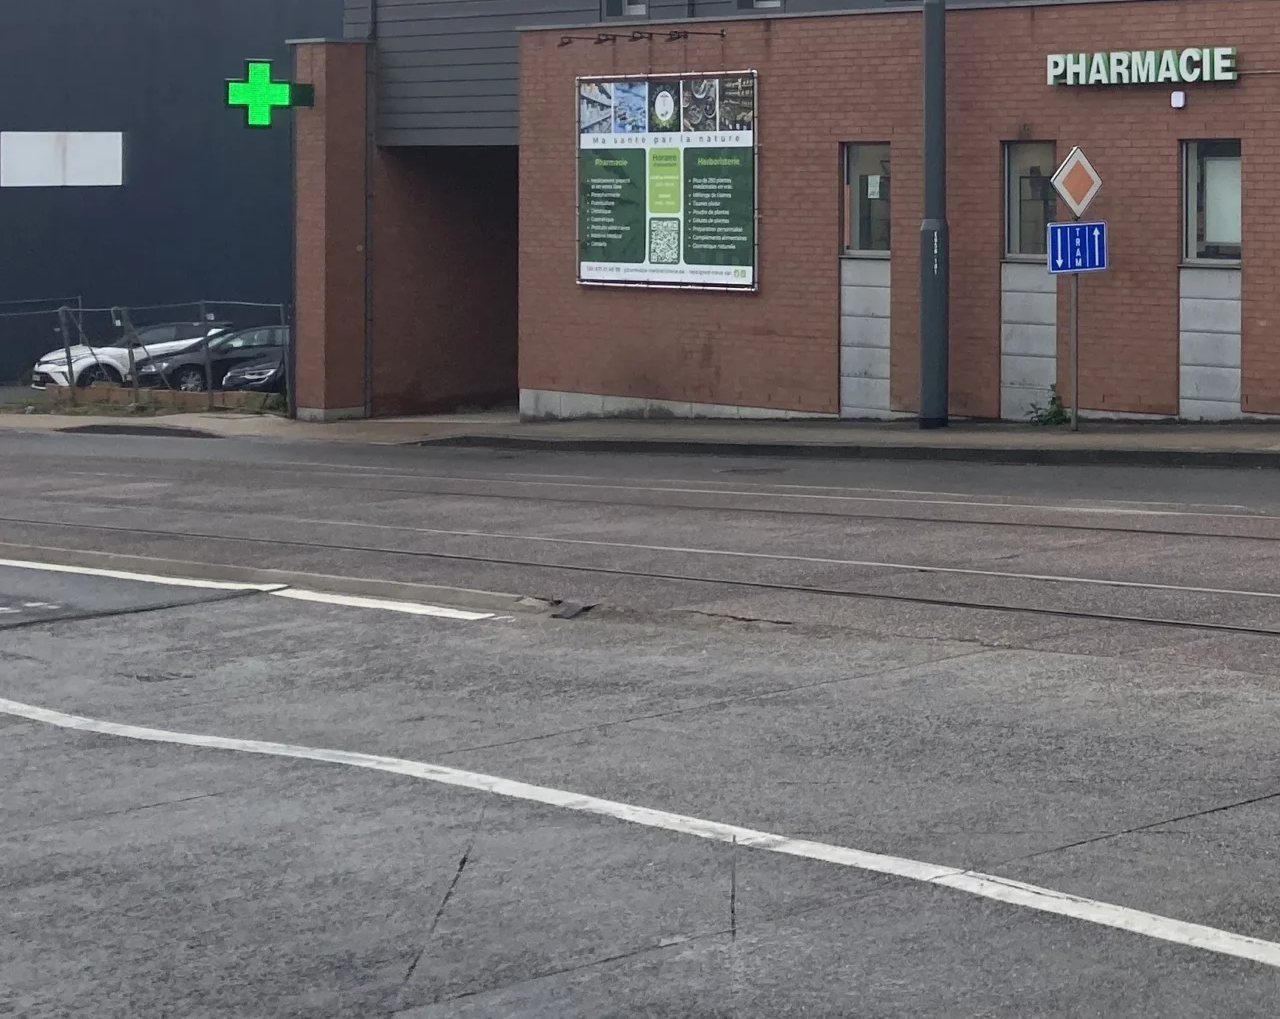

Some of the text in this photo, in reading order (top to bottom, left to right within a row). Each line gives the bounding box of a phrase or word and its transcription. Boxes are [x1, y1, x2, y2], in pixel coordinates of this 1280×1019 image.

[1047, 47, 1237, 85] PHARMACIE
[654, 135, 673, 145] par
[680, 134, 691, 143] la
[698, 135, 740, 143] nature
[594, 158, 628, 167] Pharmacie
[697, 157, 740, 166] Herboristerie
